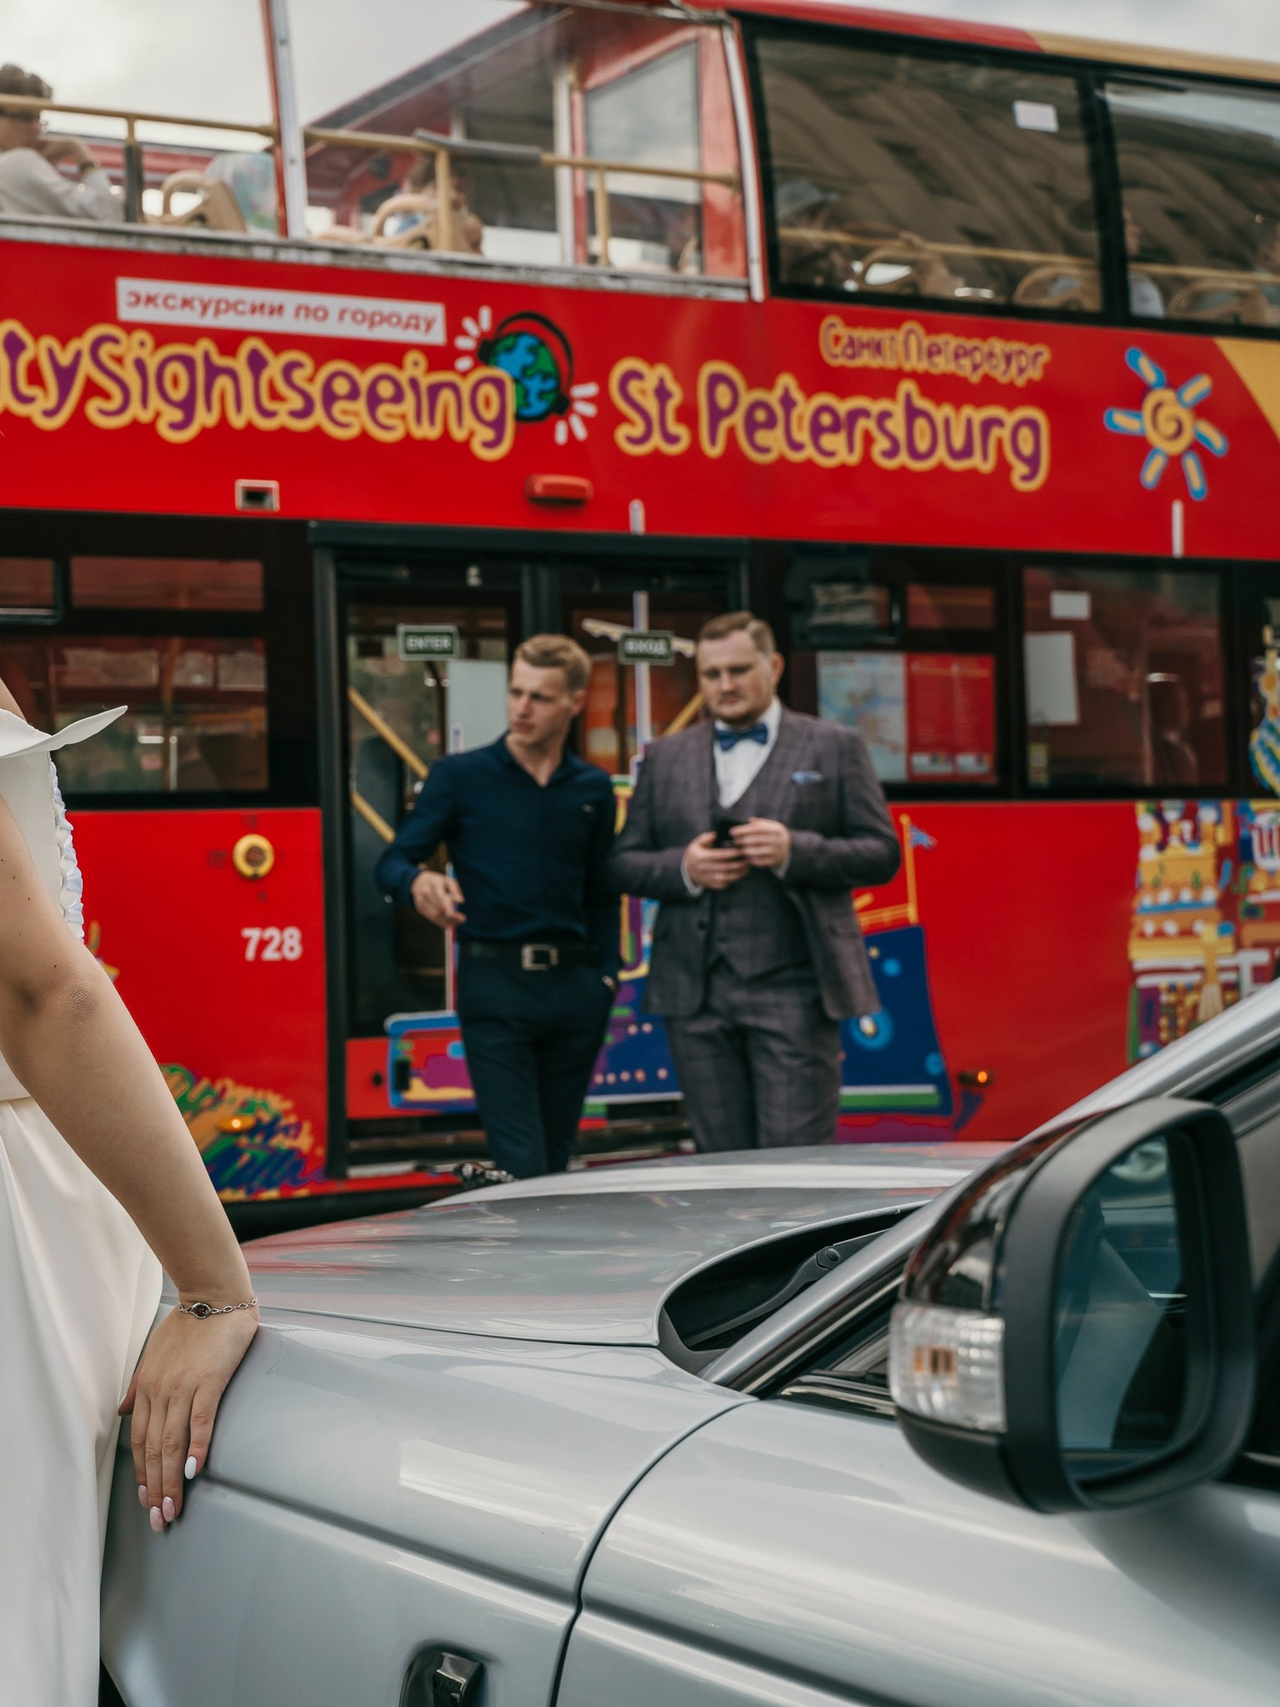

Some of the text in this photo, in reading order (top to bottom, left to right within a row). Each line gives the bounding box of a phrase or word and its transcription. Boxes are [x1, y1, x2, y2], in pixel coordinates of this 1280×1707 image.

[124, 289, 438, 336] экскурсии по городу
[610, 357, 1050, 491] St Petersburg
[406, 635, 452, 651] ENTER
[241, 925, 303, 962] 728
